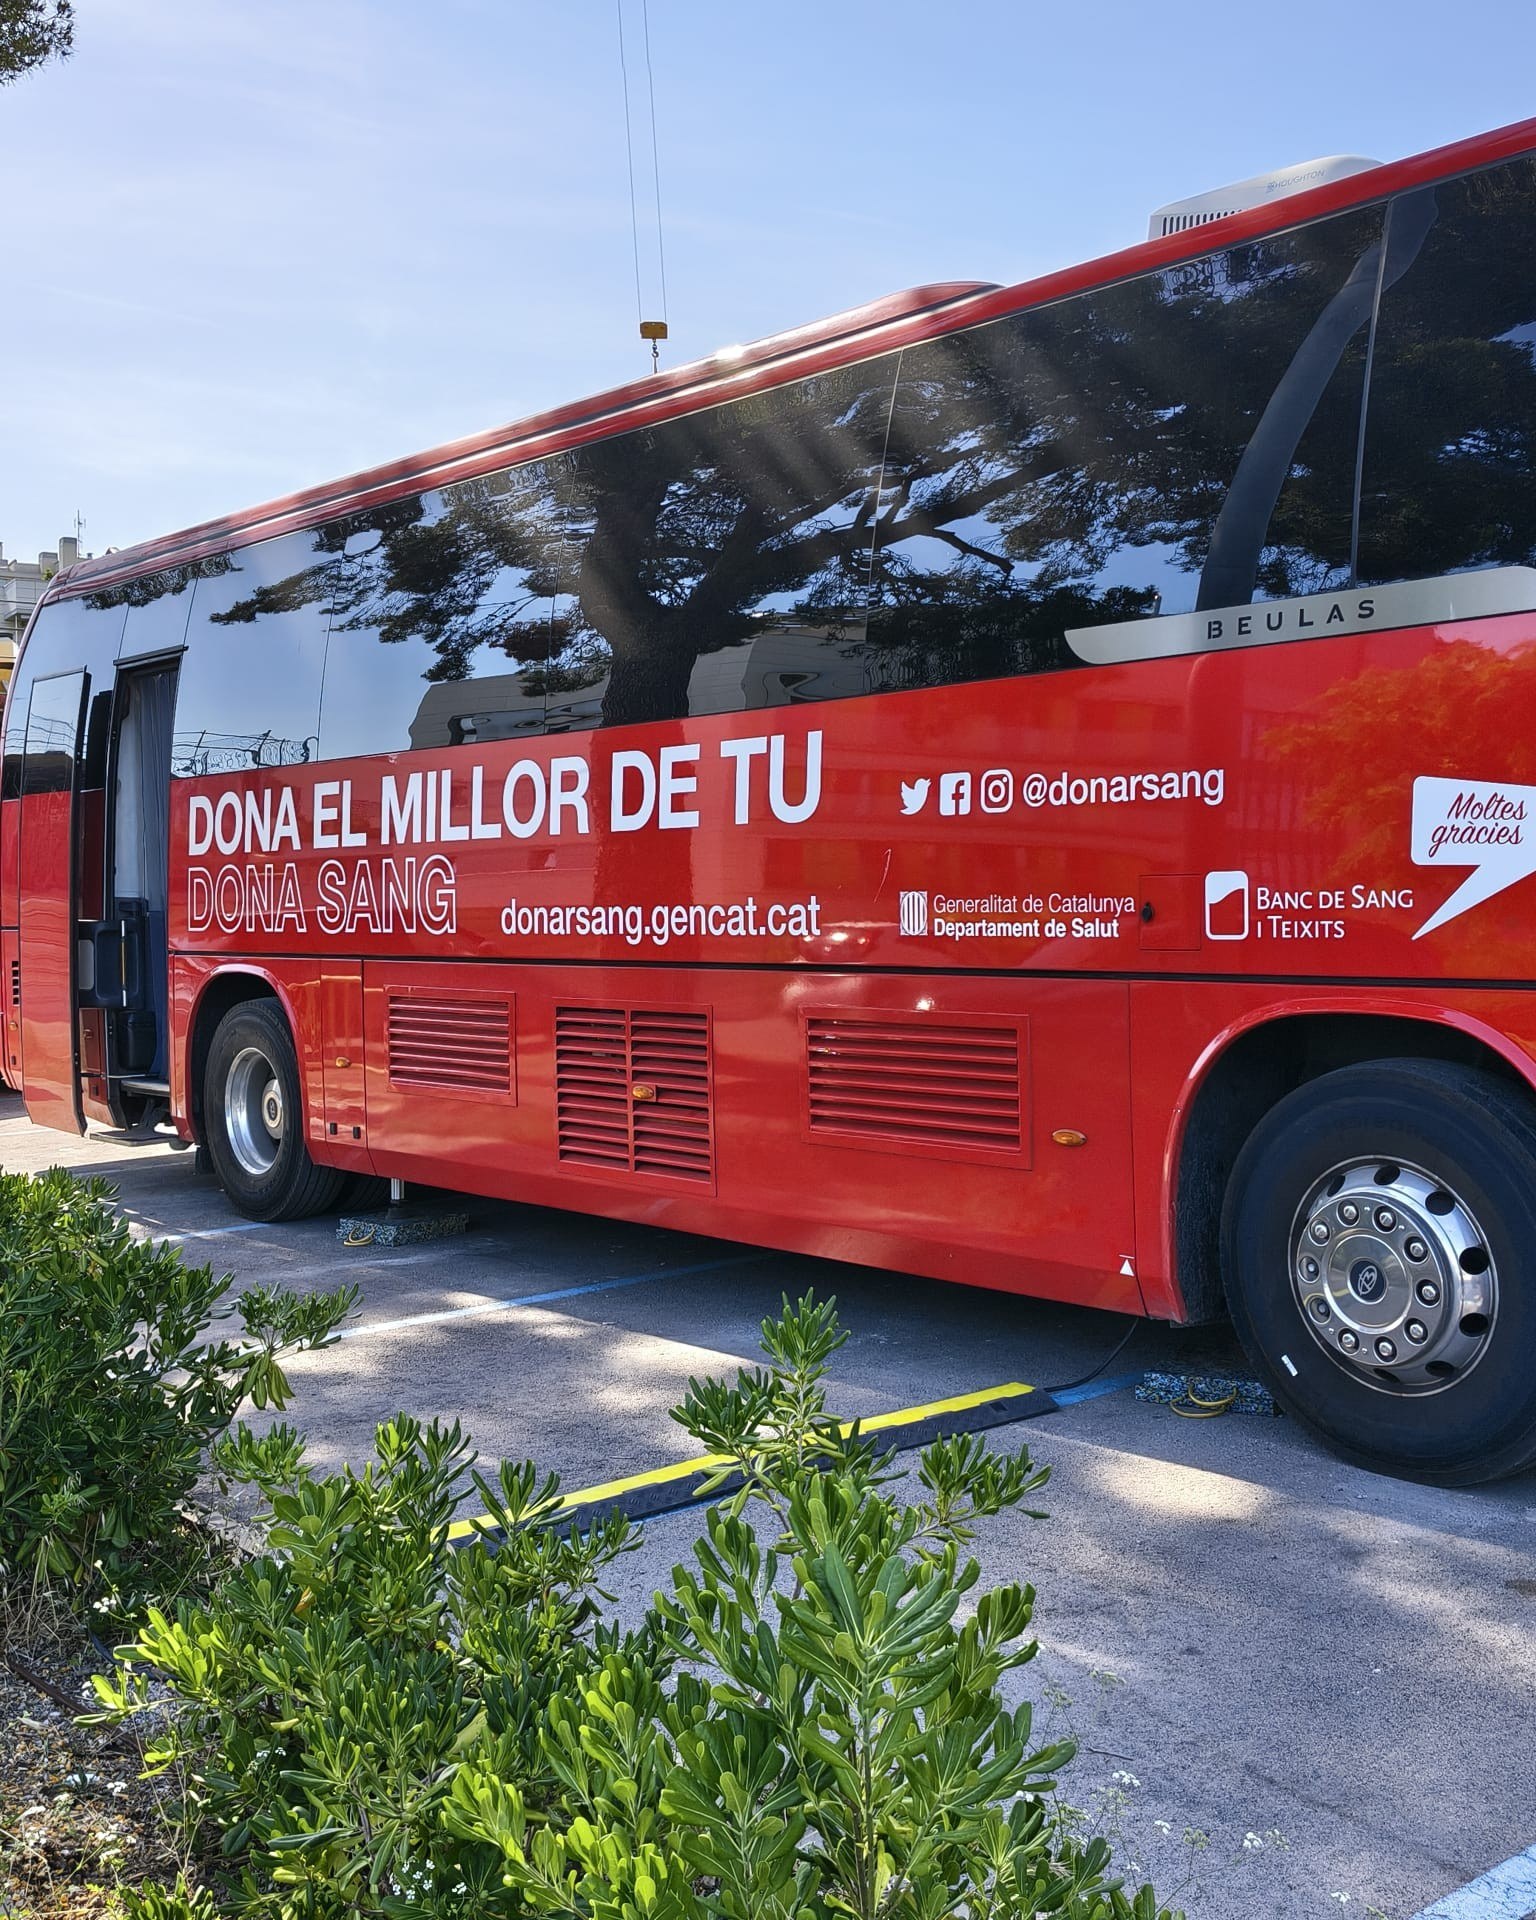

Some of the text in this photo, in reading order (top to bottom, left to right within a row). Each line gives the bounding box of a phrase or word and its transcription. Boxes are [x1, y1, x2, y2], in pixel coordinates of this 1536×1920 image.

[1274, 169, 1326, 188] HOUGHTON
[1207, 599, 1375, 640] BEULAS
[187, 730, 823, 856] DONA EL MILLOR DE TU
[1022, 768, 1225, 807] @donarsang
[1447, 792, 1528, 820] Moltes
[1428, 820, 1524, 858] gràcies
[187, 853, 457, 935] DONA SANG
[933, 893, 1136, 917] Generalitat de Catalunya
[1257, 885, 1413, 910] BANC DE SANG
[501, 896, 821, 945] donarsang.gencat.cat
[934, 917, 1119, 940] Departament de Salut
[1266, 915, 1345, 938] TEIXITS
